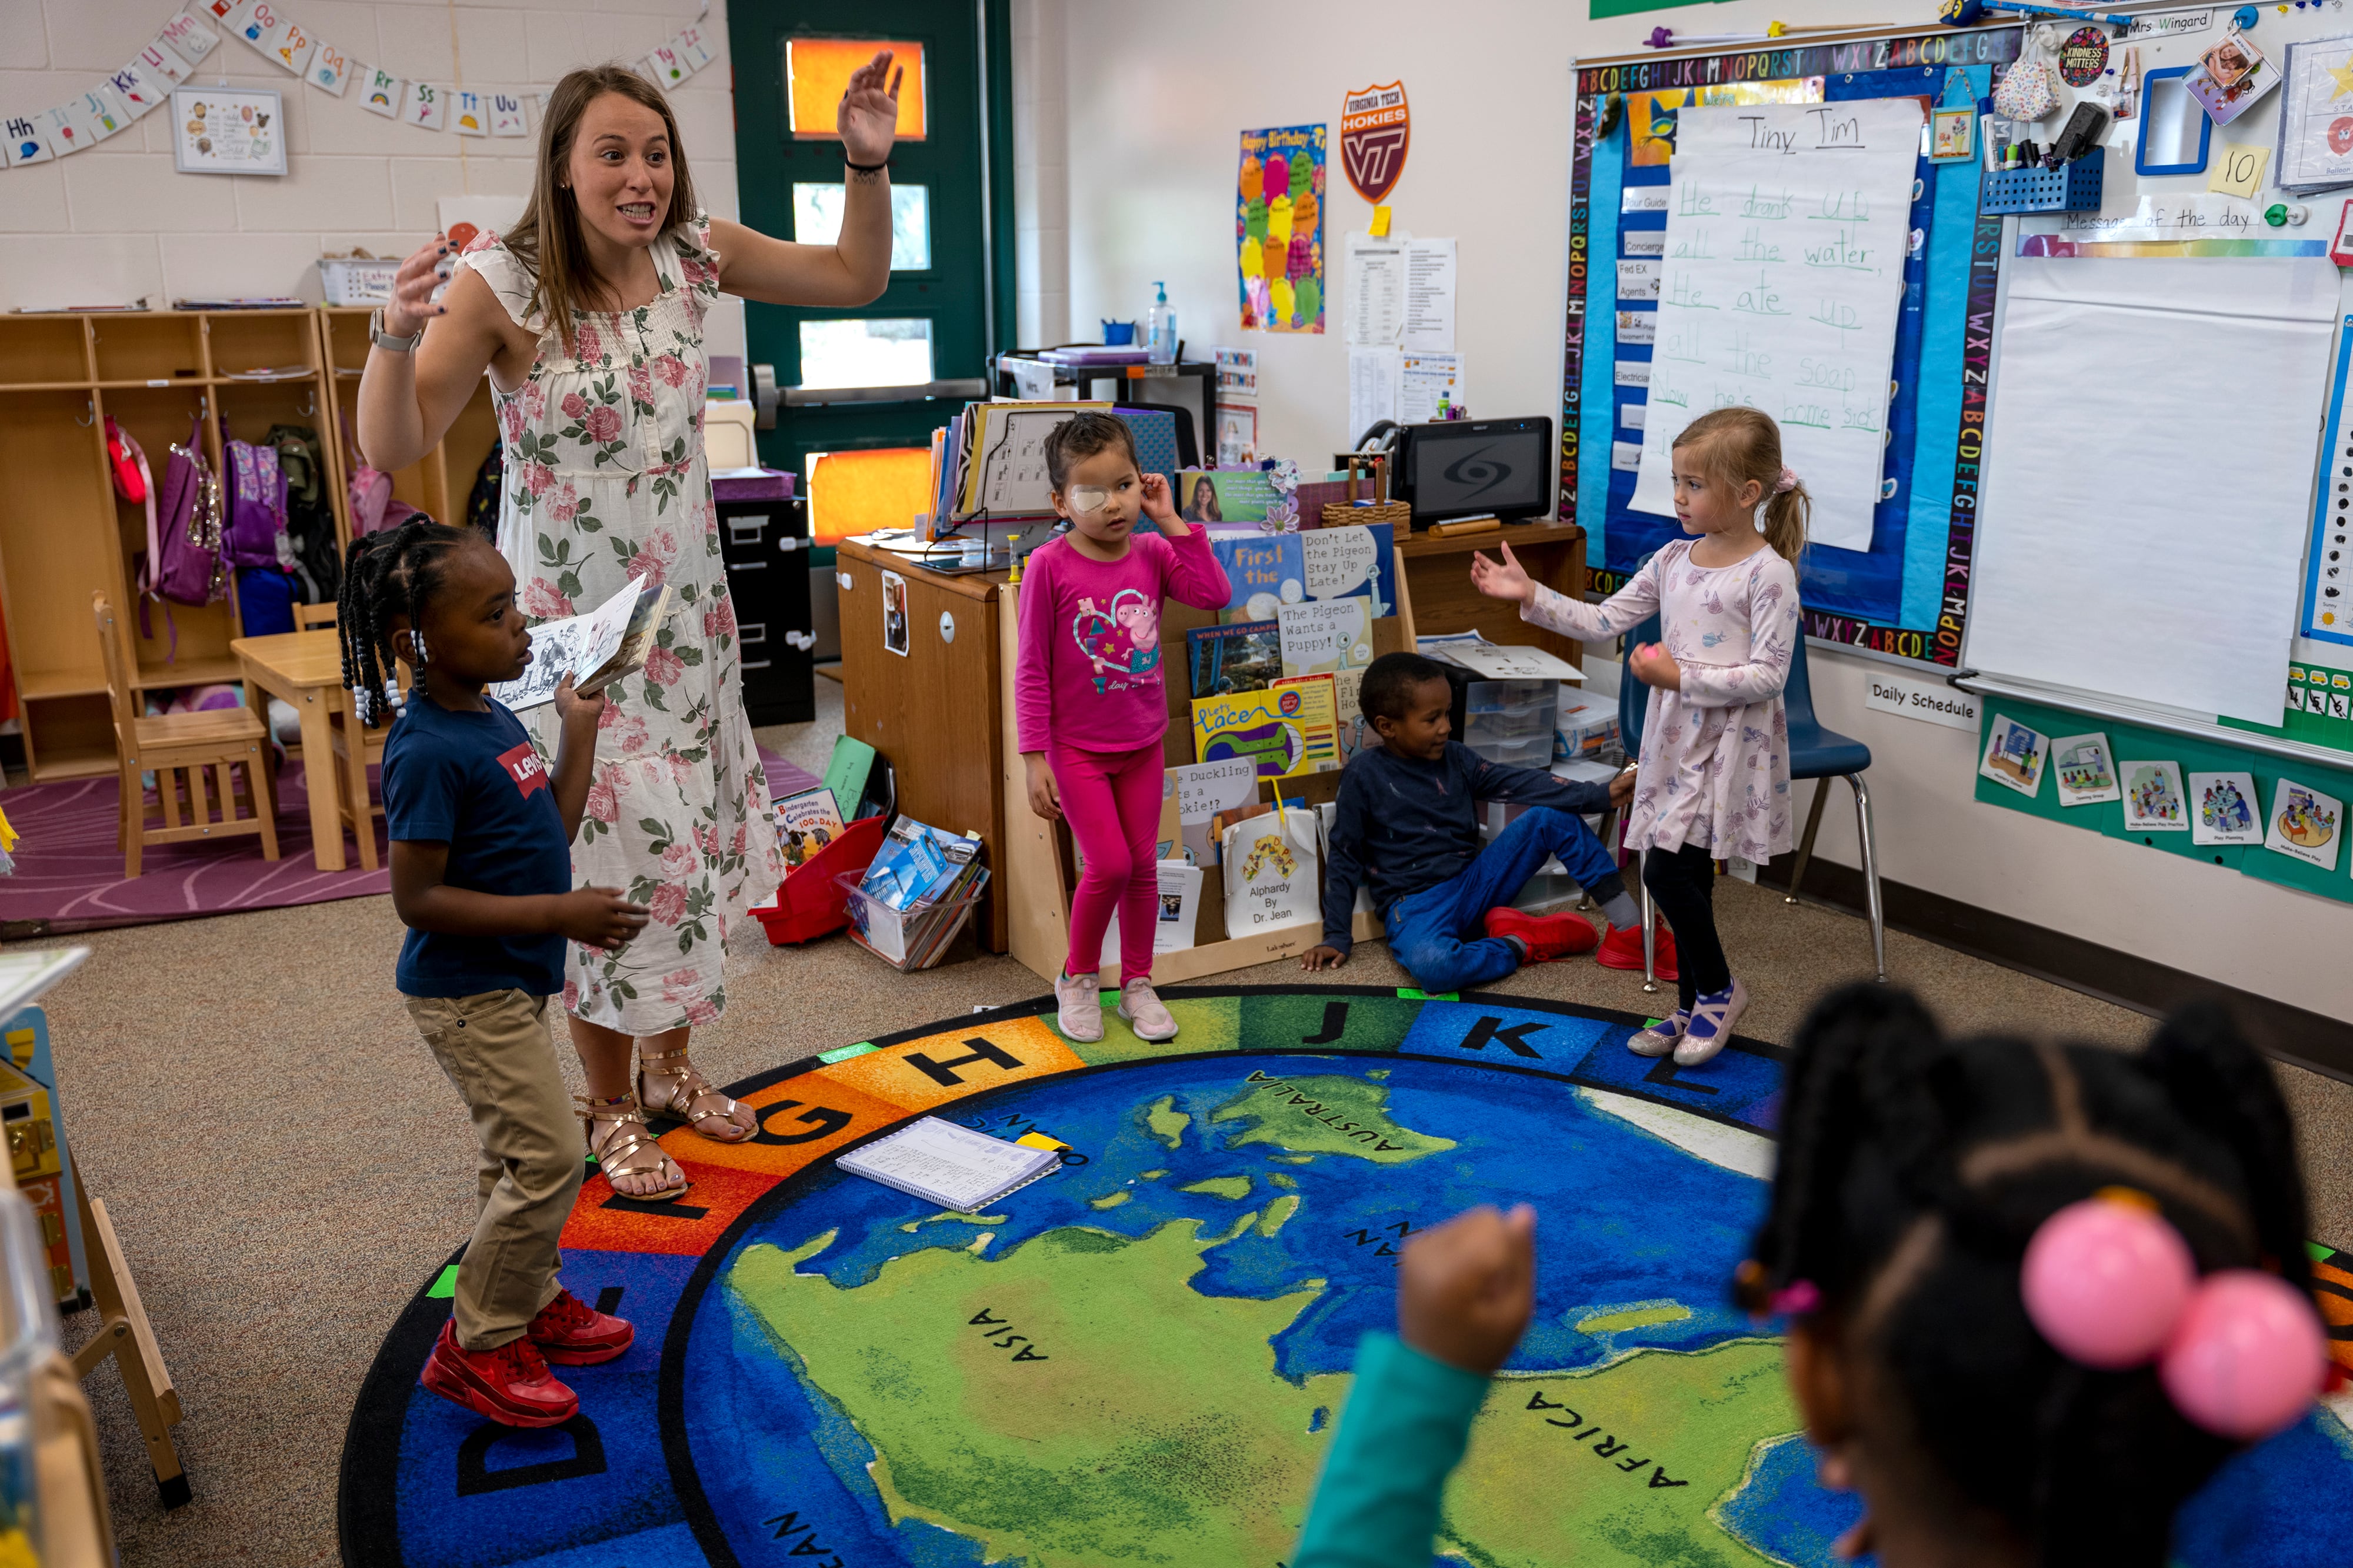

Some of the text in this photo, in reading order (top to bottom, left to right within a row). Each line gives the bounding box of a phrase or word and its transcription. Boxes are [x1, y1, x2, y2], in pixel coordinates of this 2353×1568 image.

[2130, 16, 2208, 33] Mrs. Wingard
[2067, 46, 2102, 59] KINDNESS
[2065, 58, 2101, 69] MATTERS
[1348, 91, 1400, 114] VIRGINIA TECH
[1342, 109, 1407, 131] HOKIES
[1738, 108, 1858, 154] Tiny Tim
[1240, 129, 1309, 154] Happy Birthday
[1343, 127, 1407, 187] VT
[2225, 151, 2255, 184] 10
[1644, 196, 1666, 207] Guide
[1681, 181, 1712, 213] He
[2145, 208, 2165, 227] of
[2177, 209, 2206, 228] the
[2219, 205, 2249, 233] day
[1625, 241, 1664, 254] Concierge
[1741, 227, 1780, 261] the
[1619, 264, 1647, 274] Fed EX
[1620, 286, 1646, 298] Agents
[1737, 270, 1784, 314] ate
[1218, 371, 1255, 389] EETINGS
[1654, 370, 1688, 406] Now
[1305, 531, 1365, 547] Don't Let
[1235, 545, 1284, 568] First
[1306, 544, 1372, 559] the Pigeon
[1244, 567, 1278, 584] the
[1308, 559, 1359, 576] Stay Up
[1308, 573, 1346, 588] Late!
[1283, 602, 1355, 622] The Pigeon
[1197, 630, 1221, 639] WHEN
[1236, 627, 1248, 635] GO
[1285, 620, 1337, 636] Wants a
[1287, 637, 1332, 653] Puppy!
[1108, 680, 1129, 692] day
[1207, 703, 1231, 717] Let's
[1872, 683, 1974, 719] Daily Schedule
[1195, 708, 1252, 733] Lace
[1190, 765, 1249, 782] Duckling
[778, 800, 819, 815] Bindergarten
[786, 806, 831, 824] Celebrates the
[819, 818, 837, 828] DAY
[2280, 843, 2322, 863] Make-Believe Play
[1249, 882, 1291, 898] Alphardy
[1265, 898, 1277, 909] By
[1253, 909, 1292, 923] Dr. Jean
[1302, 1002, 1349, 1044] J
[1459, 1016, 1552, 1059] K
[903, 1037, 1025, 1087] H
[1244, 1068, 1404, 1151] AUSTRALIA
[758, 1099, 852, 1146] G
[968, 1307, 1049, 1362] ASIA
[1525, 1390, 1689, 1489] AFRICA
